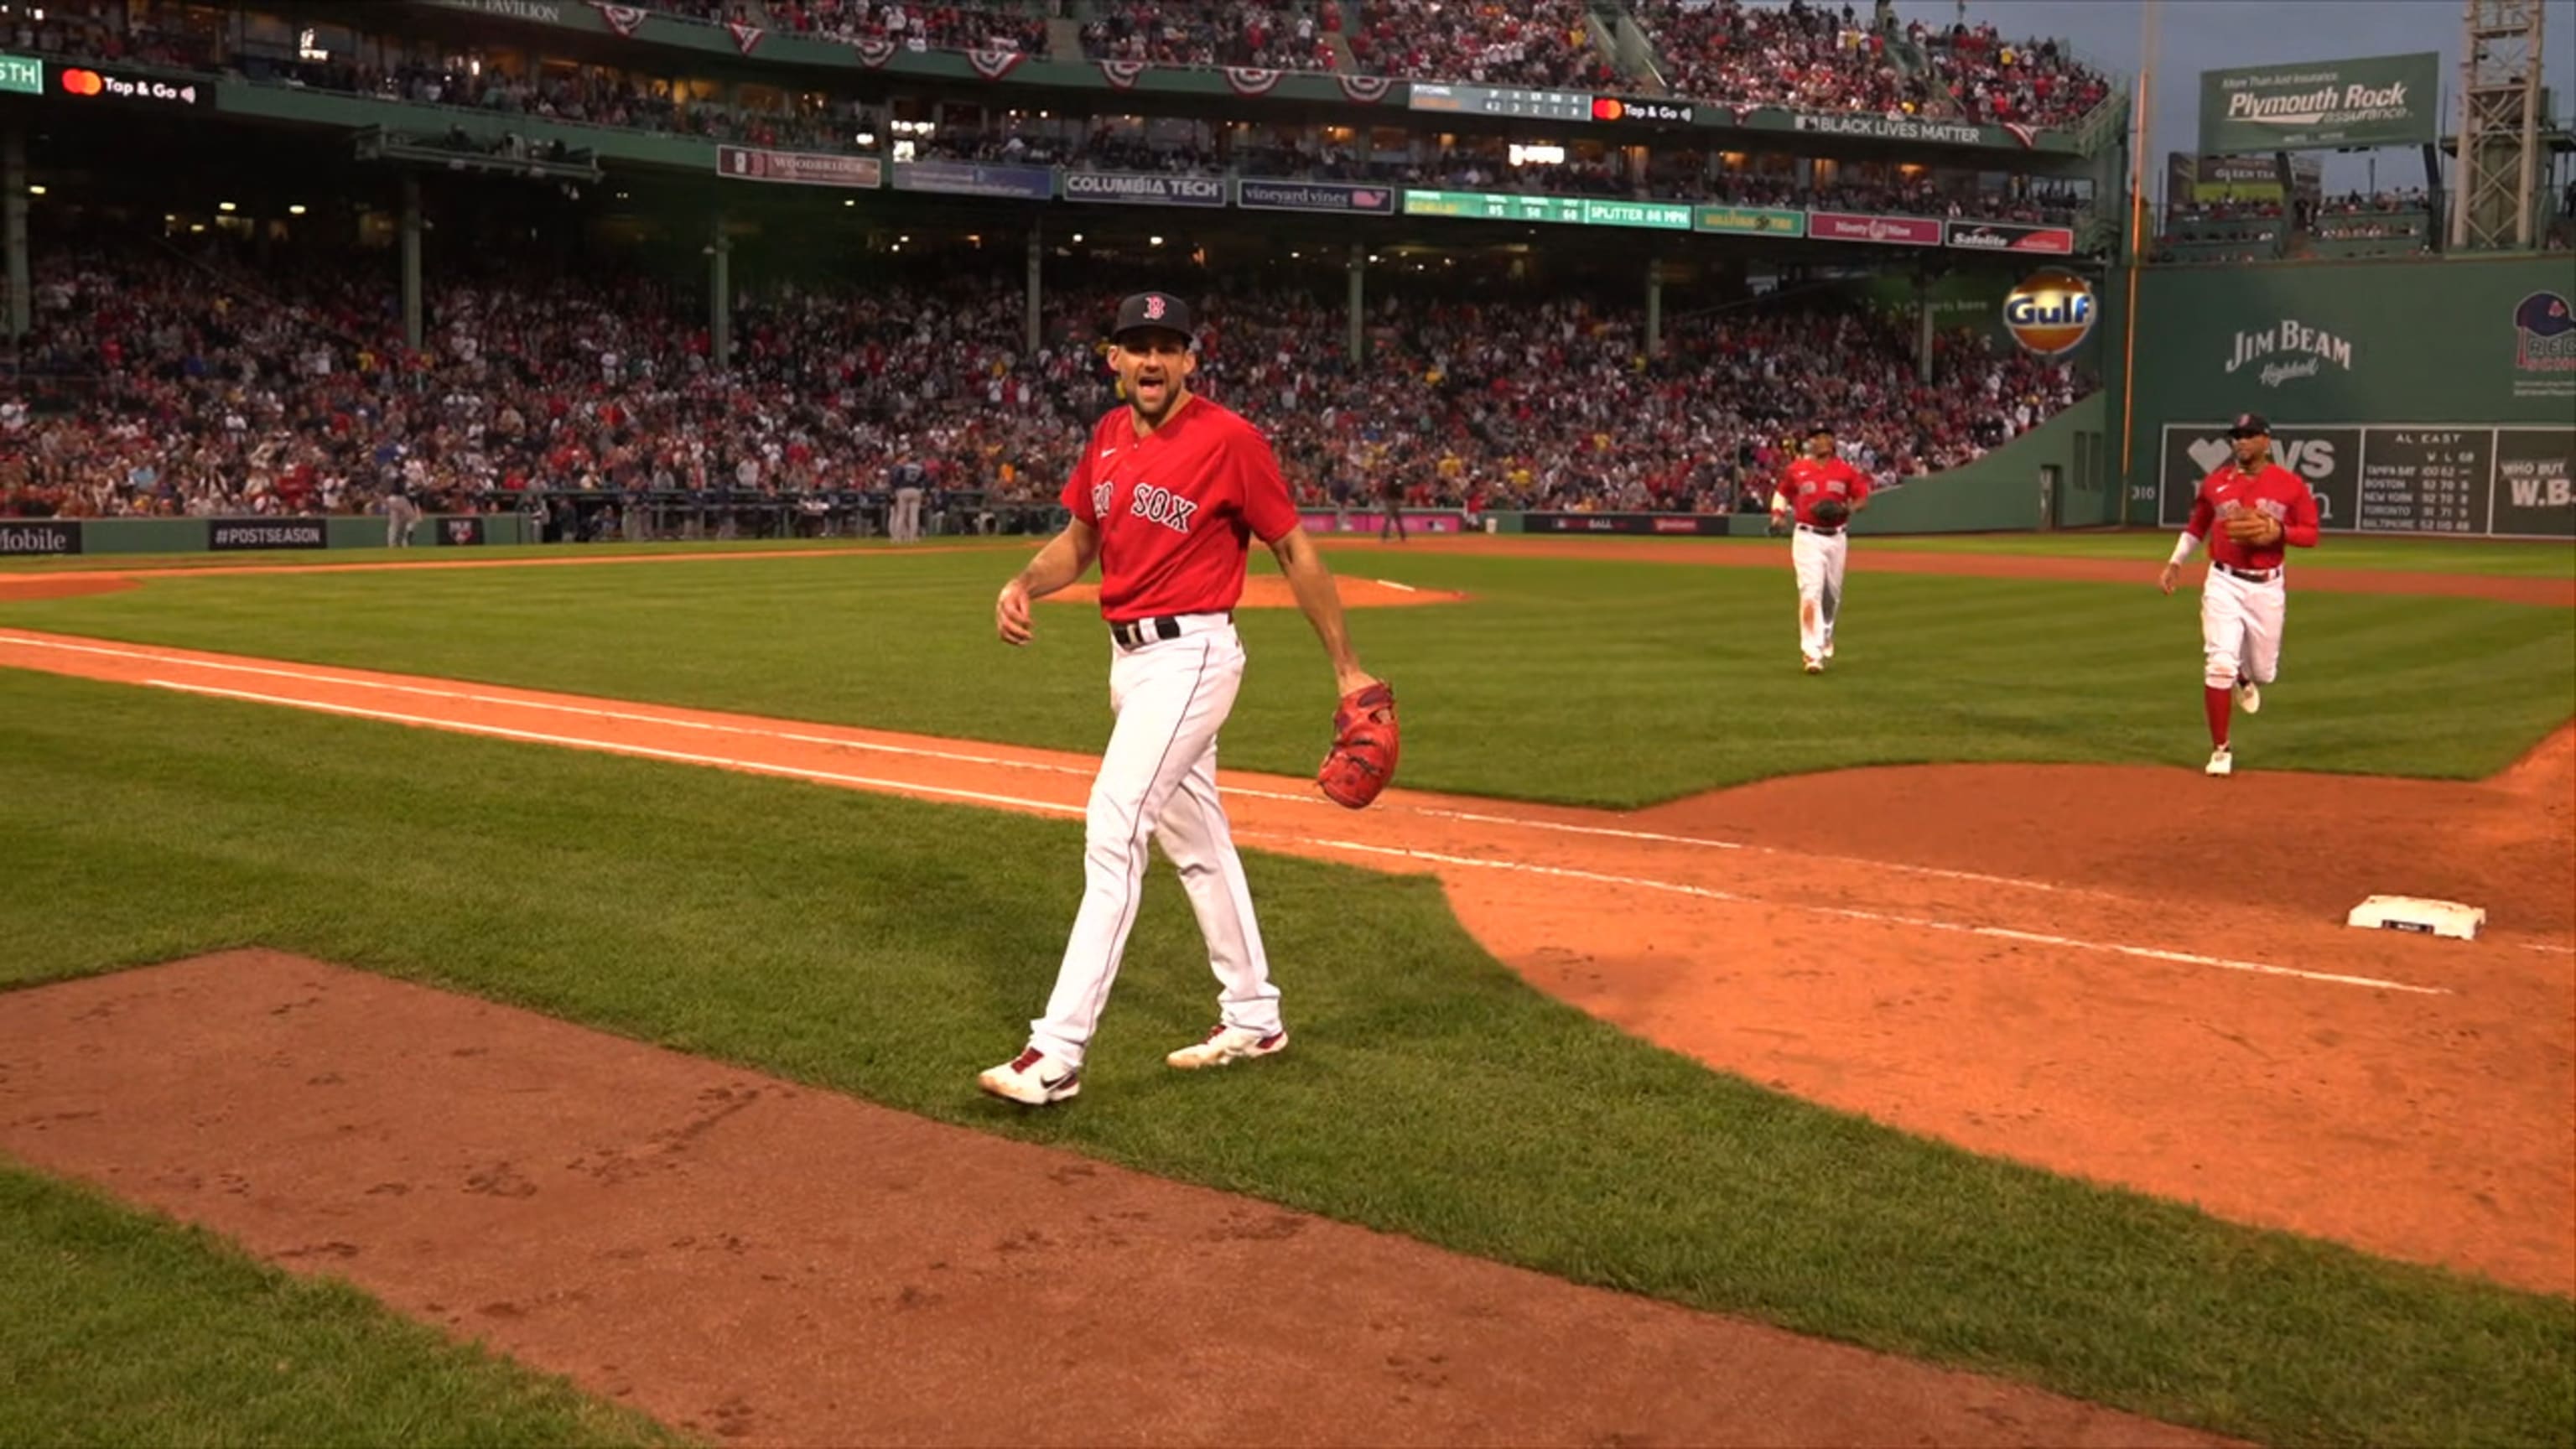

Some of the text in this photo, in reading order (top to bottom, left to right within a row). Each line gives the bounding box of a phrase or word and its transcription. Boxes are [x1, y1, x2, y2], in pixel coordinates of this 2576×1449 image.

[137, 81, 149, 96] &
[153, 84, 177, 99] Go
[2227, 81, 2407, 117] Plymouth Rock
[1660, 108, 1678, 120] Go
[2324, 106, 2407, 123] assurance
[1820, 117, 1981, 143] BLACK LIVES MATTER
[1067, 176, 1218, 197] COLUMBIA TECH
[1245, 185, 1309, 204] vineyard
[1592, 206, 1643, 221] SPLITTER
[1954, 231, 2008, 247] Safelite
[1144, 296, 1166, 319] B
[2007, 293, 2091, 325] Gulf
[2225, 319, 2352, 373] JIM BEAM
[2395, 434, 2462, 444] AL EAST
[2270, 439, 2336, 478] VS
[2501, 461, 2565, 476] WHO BUT
[2131, 486, 2155, 501] 310
[2364, 479, 2407, 490] BOSTON
[2440, 480, 2455, 491] 70
[2364, 492, 2385, 502] NEW
[2387, 493, 2413, 503] YORK
[1132, 482, 1197, 533] SOX
[2364, 505, 2411, 517] TORONTO
[2441, 507, 2453, 517] 71
[216, 527, 320, 544] #POSTSEASON
